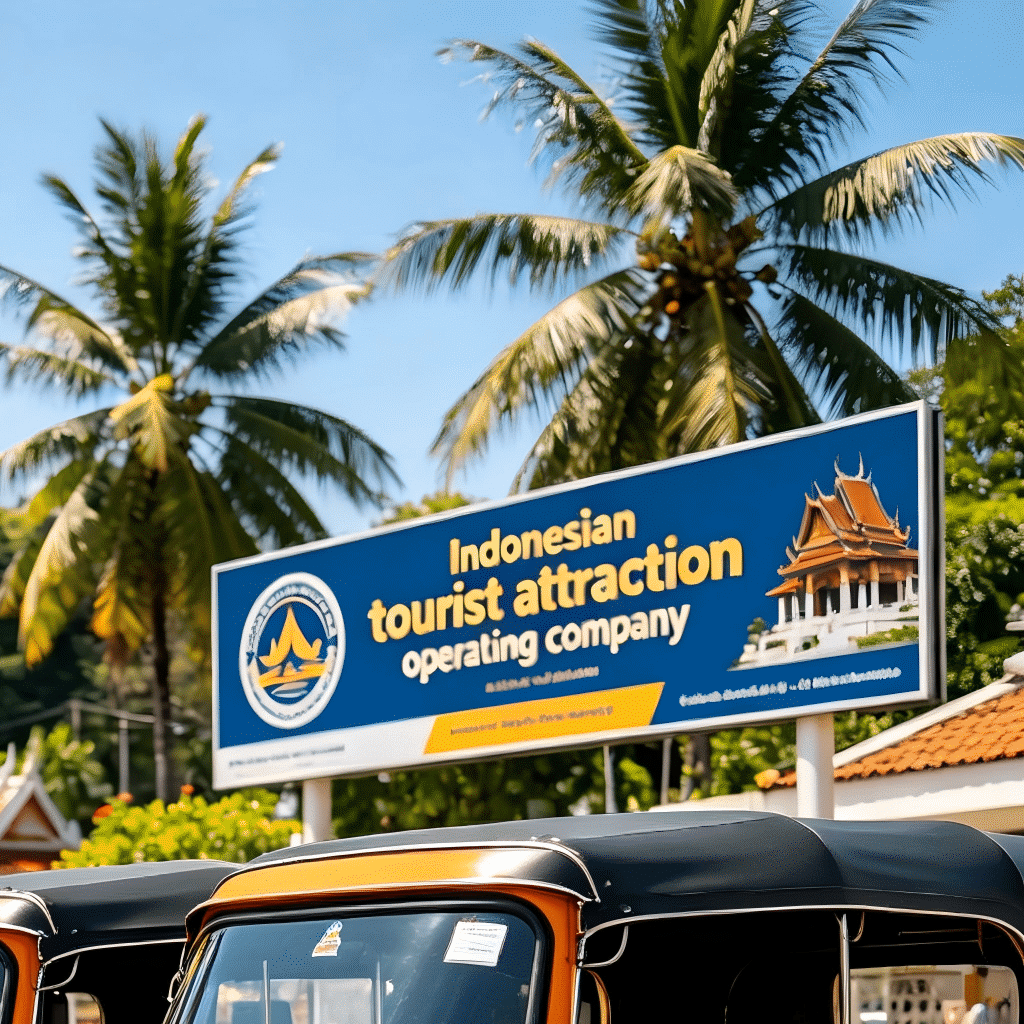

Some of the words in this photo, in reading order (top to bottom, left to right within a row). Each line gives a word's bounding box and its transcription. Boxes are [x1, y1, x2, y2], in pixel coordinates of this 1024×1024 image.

[449, 507, 636, 575] Indonesian
[367, 577, 505, 643] tourist
[513, 534, 744, 618] attraction
[401, 628, 538, 684] operating
[545, 604, 691, 654] company
